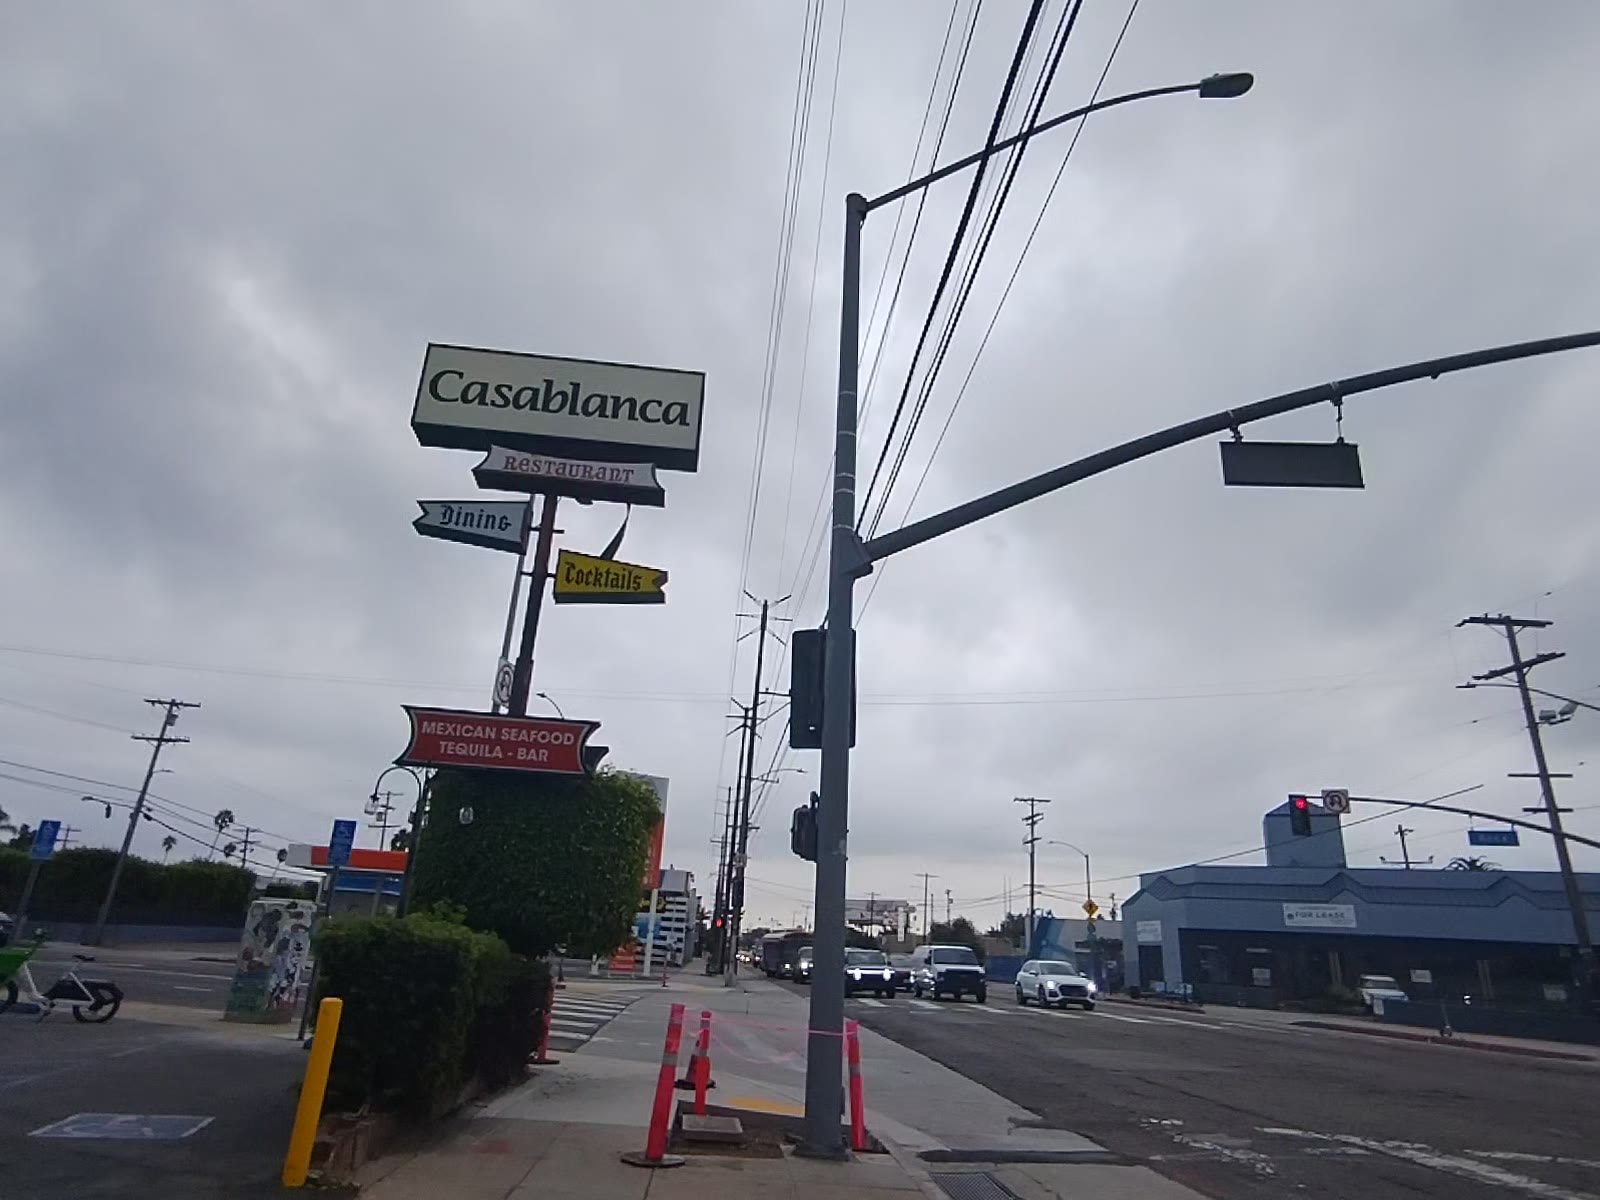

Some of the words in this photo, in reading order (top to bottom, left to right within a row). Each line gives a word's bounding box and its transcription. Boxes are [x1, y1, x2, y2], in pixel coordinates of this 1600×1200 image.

[428, 369, 690, 427] Casablanca
[564, 561, 643, 591] Cocktails
[421, 720, 496, 740] MEXICAN
[501, 727, 575, 745] SEAFOOD
[439, 740, 504, 758] TEQUILA
[517, 747, 549, 762] BAR
